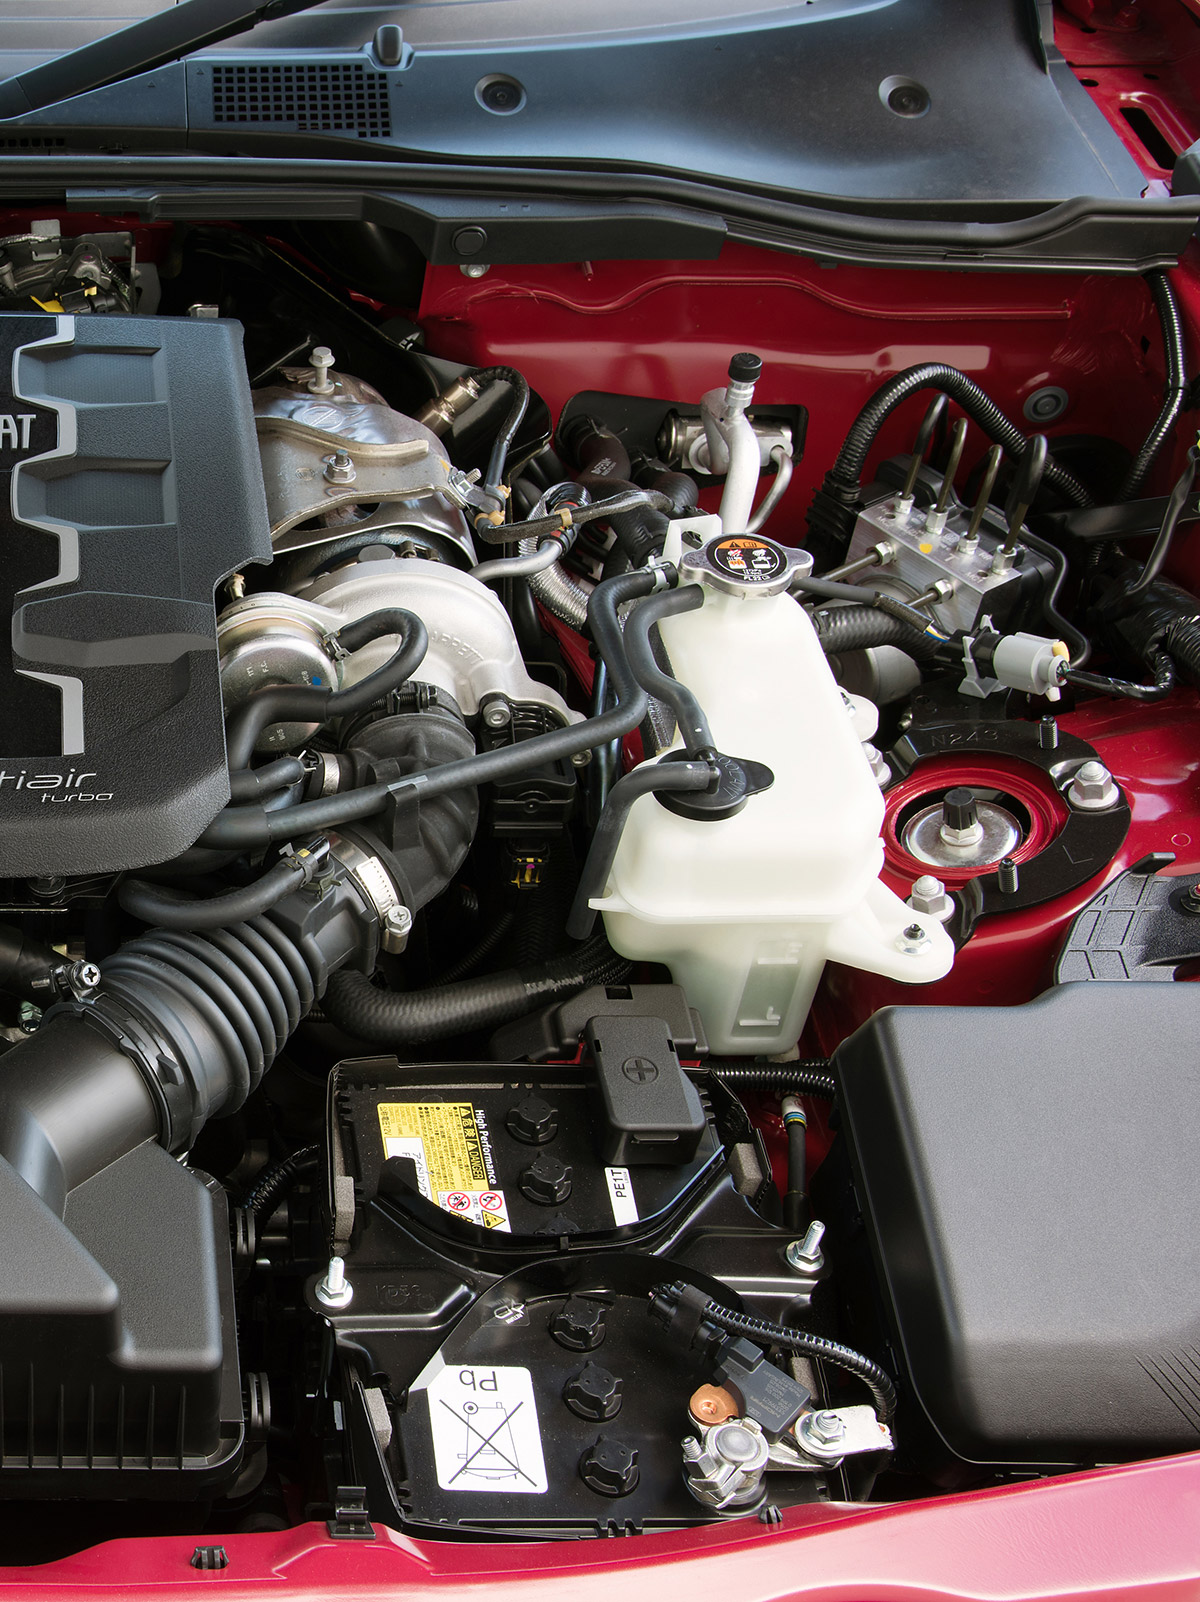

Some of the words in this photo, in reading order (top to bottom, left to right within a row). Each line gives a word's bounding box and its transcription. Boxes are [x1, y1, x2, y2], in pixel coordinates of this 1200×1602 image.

[931, 727, 999, 747] N243
[718, 756, 745, 800] OOLANT
[41, 791, 114, 804] turbo
[766, 1006, 781, 1020] L
[474, 1109, 487, 1129] High
[469, 1151, 483, 1180] DANGER
[478, 1131, 498, 1185] Performance
[611, 1168, 628, 1199] PE1T
[459, 1370, 499, 1393] Pb
